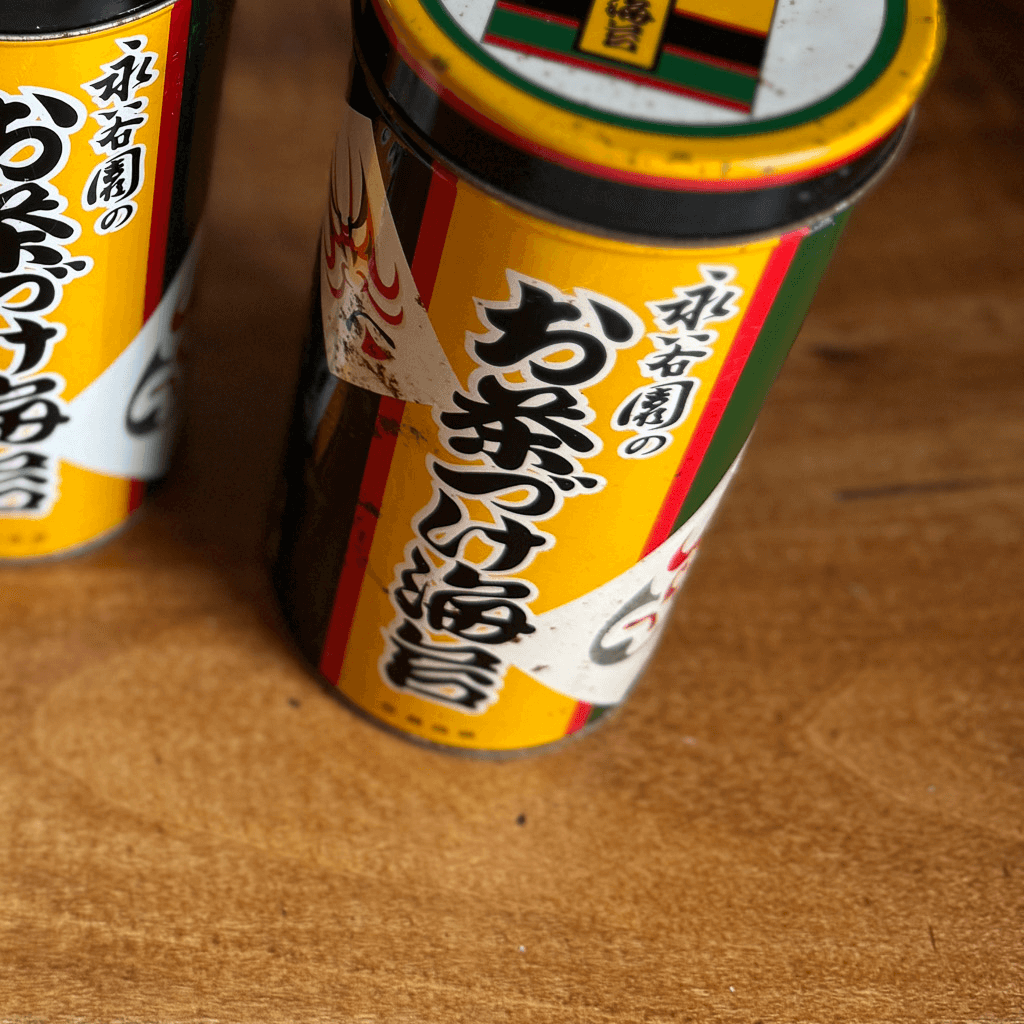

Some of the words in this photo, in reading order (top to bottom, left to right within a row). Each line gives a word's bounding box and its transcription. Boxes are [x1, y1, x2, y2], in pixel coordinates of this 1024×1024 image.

[86, 39, 158, 229] 永谷園の
[616, 268, 736, 456] 永谷園の
[387, 282, 635, 710] お茶づけ海苔
